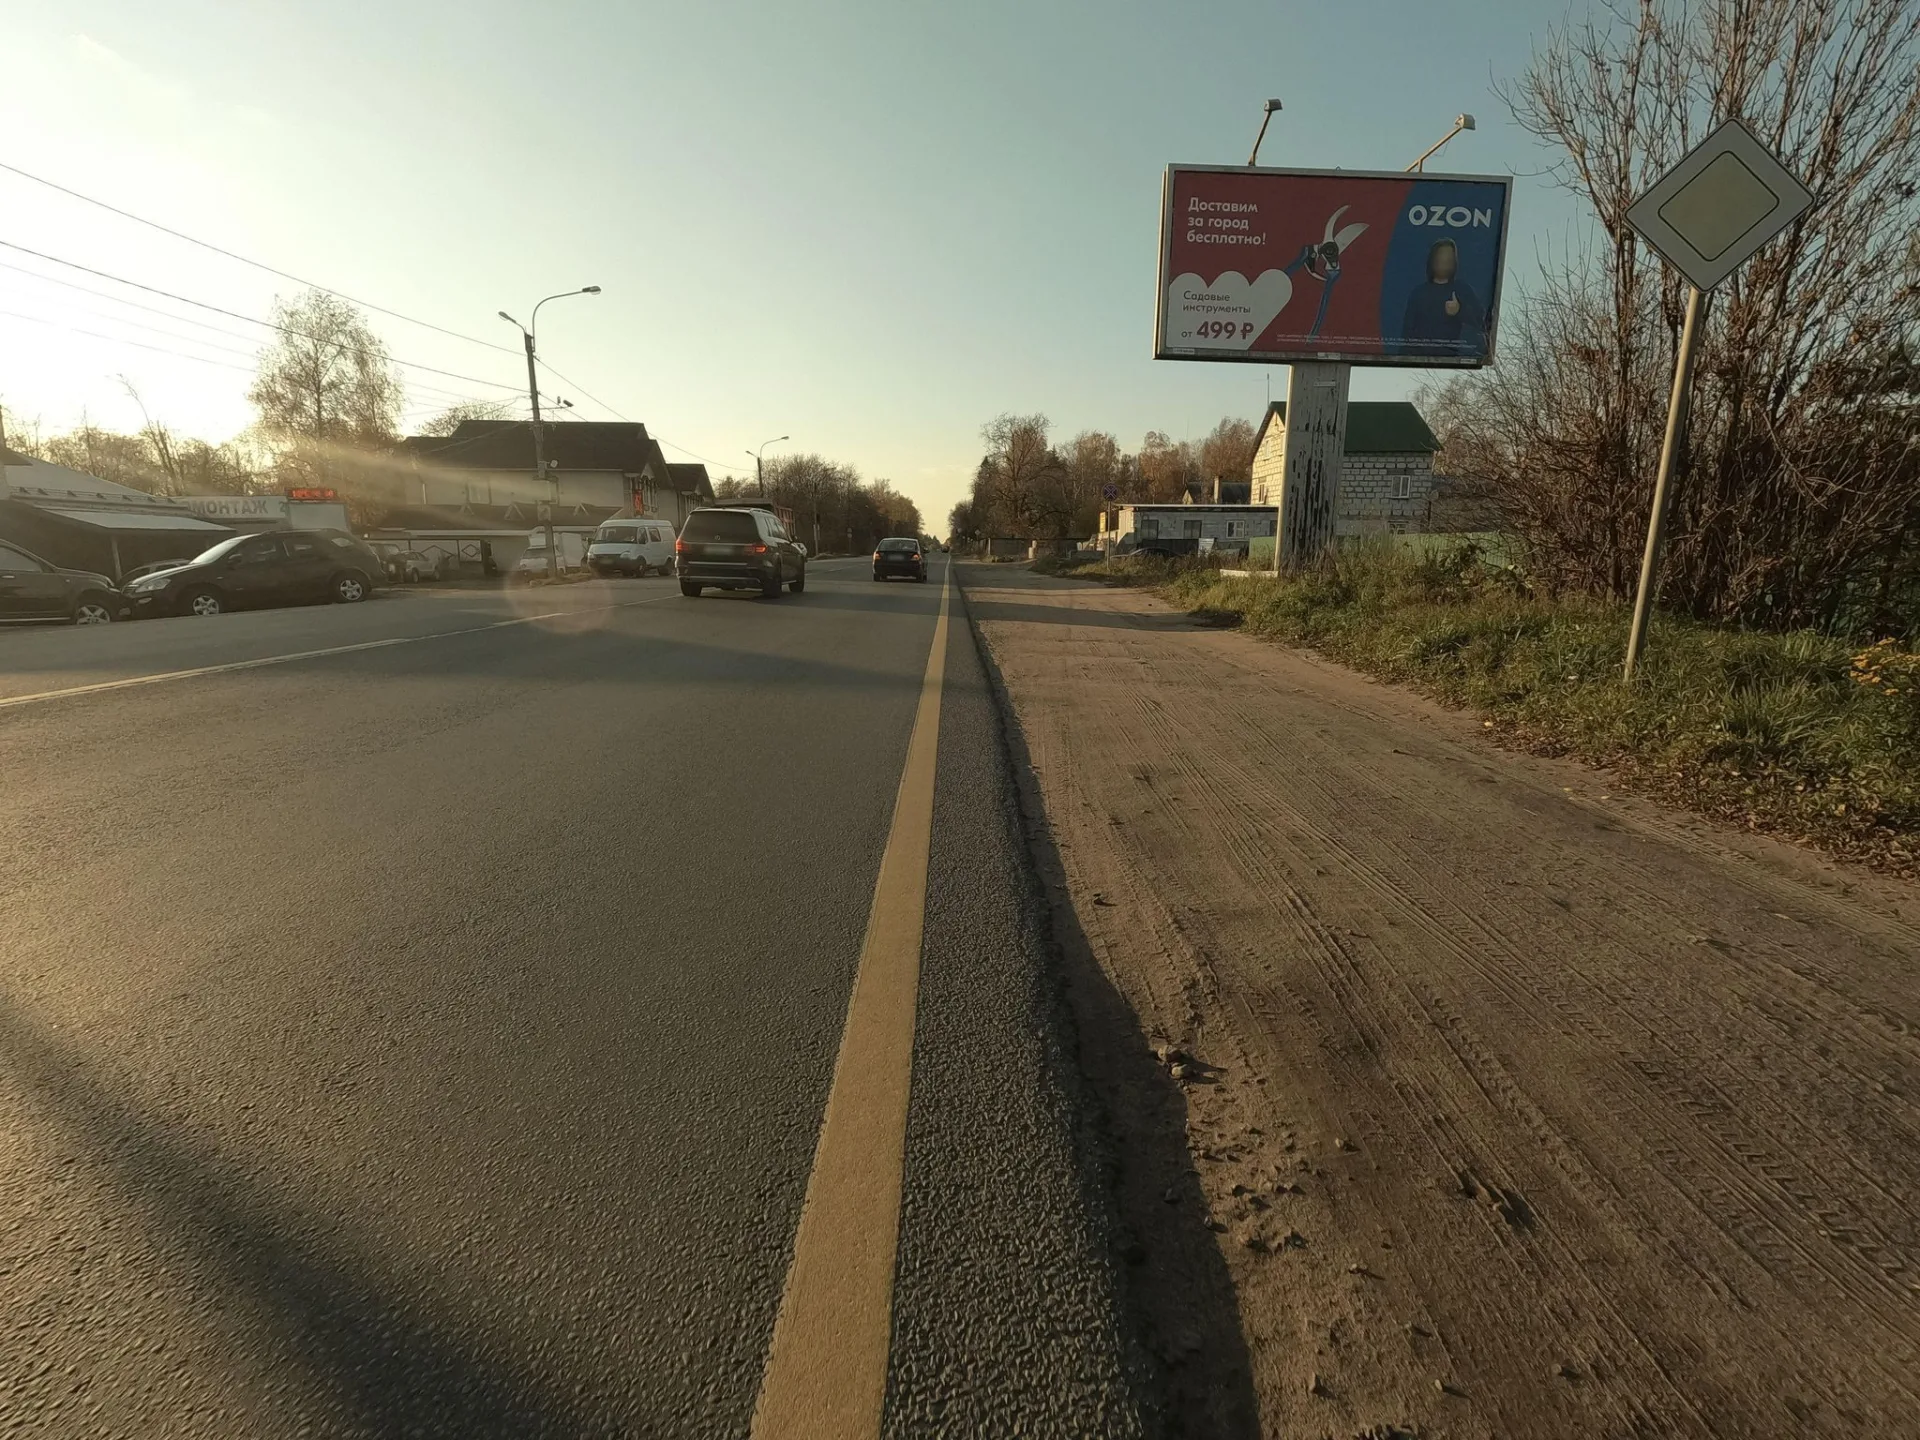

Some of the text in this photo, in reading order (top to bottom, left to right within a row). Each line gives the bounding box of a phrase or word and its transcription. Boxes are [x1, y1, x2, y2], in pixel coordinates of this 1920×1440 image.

[1188, 197, 1258, 213] Доставим
[1188, 217, 1249, 231] за город
[1408, 204, 1492, 228] OZON
[1186, 229, 1266, 245] бесплатно!
[1183, 290, 1231, 302] Садовые
[1182, 303, 1251, 315] инструменты
[1181, 330, 1193, 338] от
[1196, 321, 1237, 339] 499
